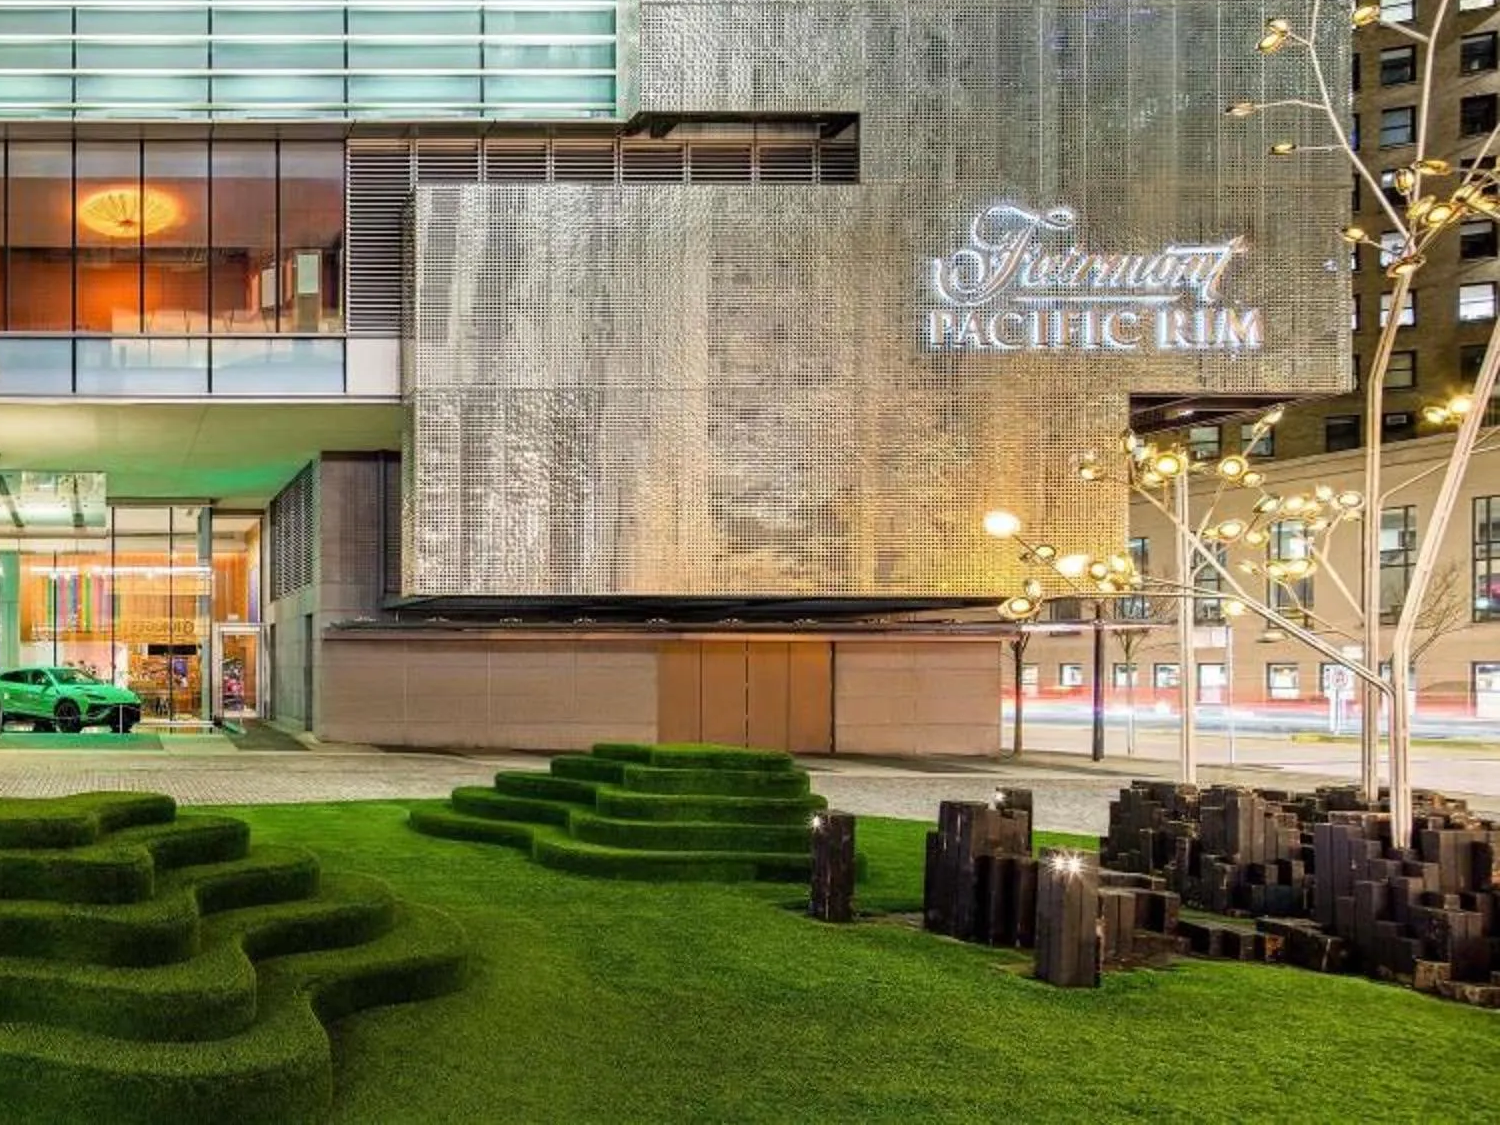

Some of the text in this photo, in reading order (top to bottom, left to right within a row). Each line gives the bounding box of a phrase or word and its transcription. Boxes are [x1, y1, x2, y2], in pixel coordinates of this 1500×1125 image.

[934, 203, 1248, 305] Fairmont
[930, 309, 1263, 348] PACIFIC RIM
